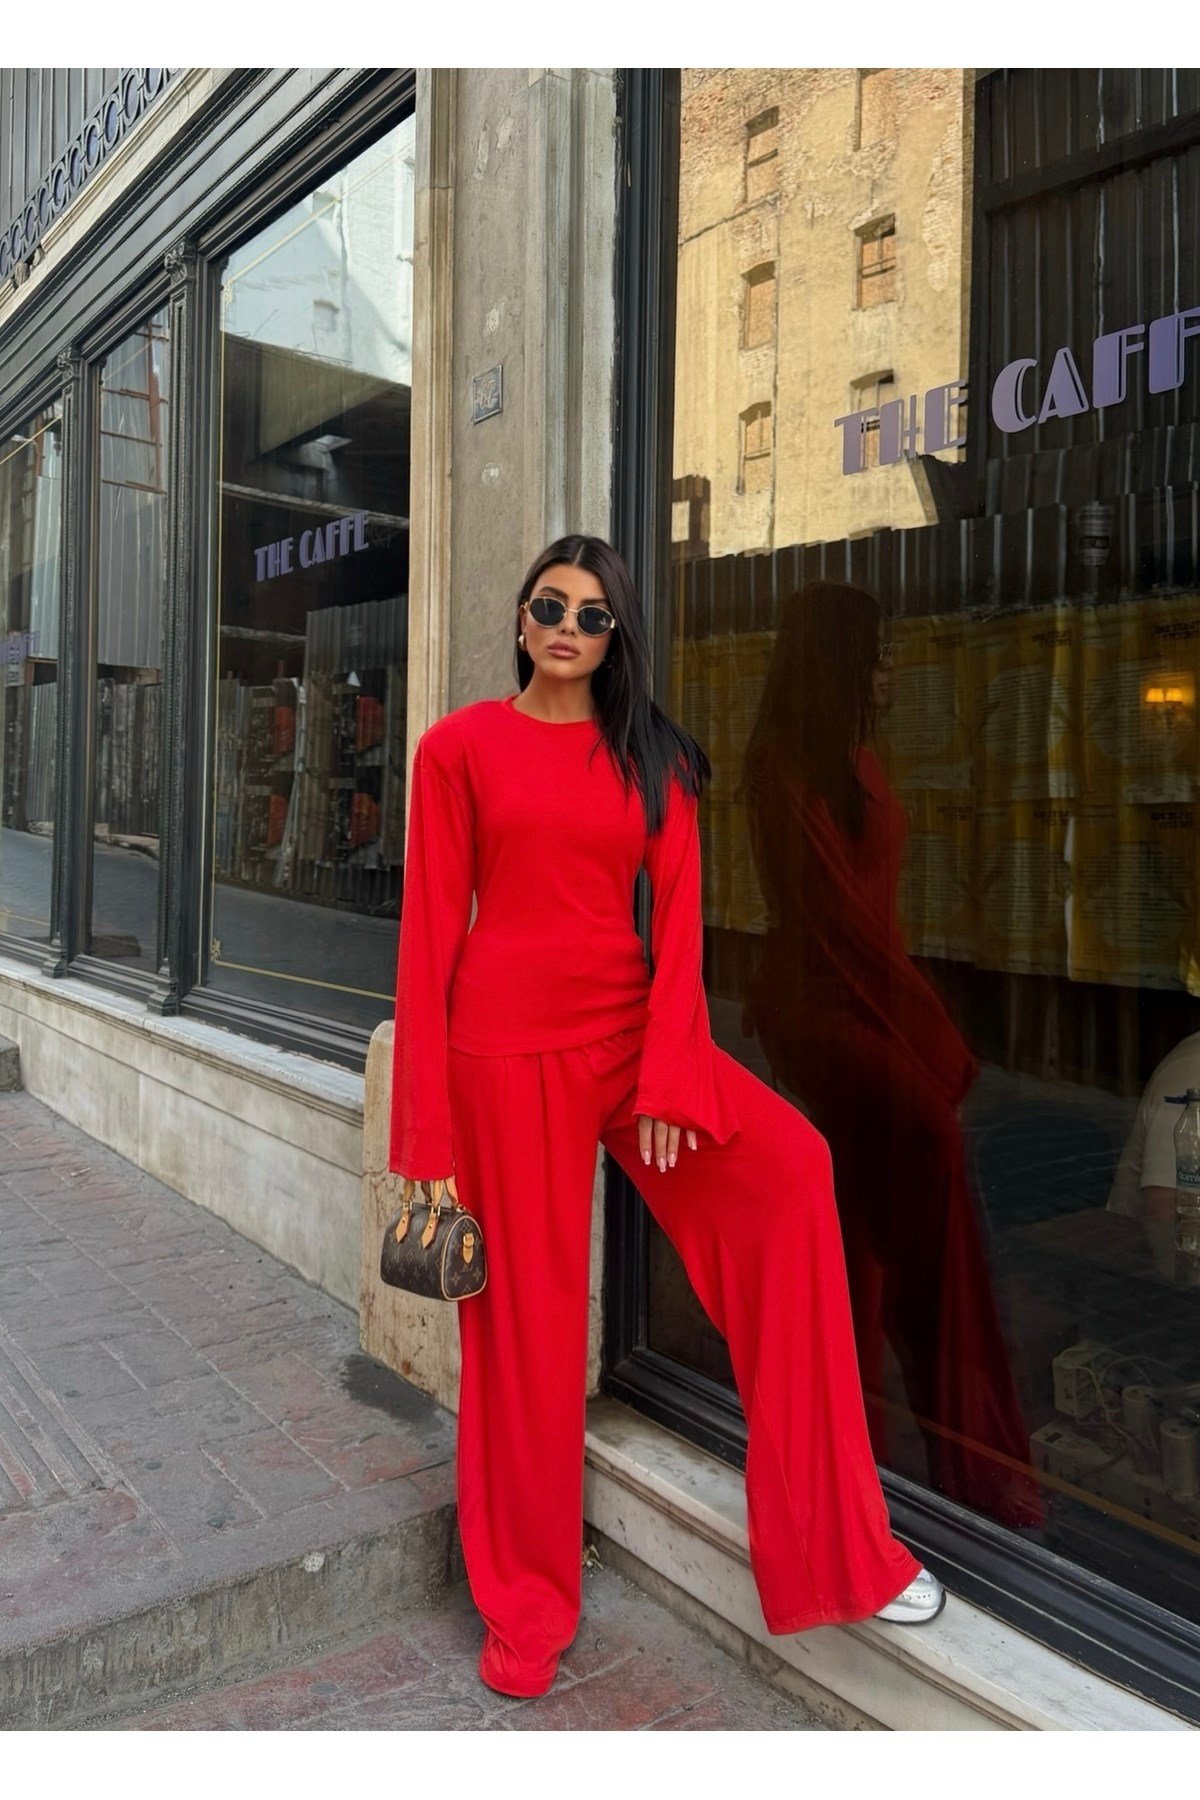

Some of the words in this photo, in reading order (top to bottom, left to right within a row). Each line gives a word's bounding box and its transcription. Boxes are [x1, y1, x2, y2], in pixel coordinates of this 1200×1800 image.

[834, 379, 967, 476] THE
[254, 537, 293, 582] THE
[299, 510, 369, 568] CAFFE
